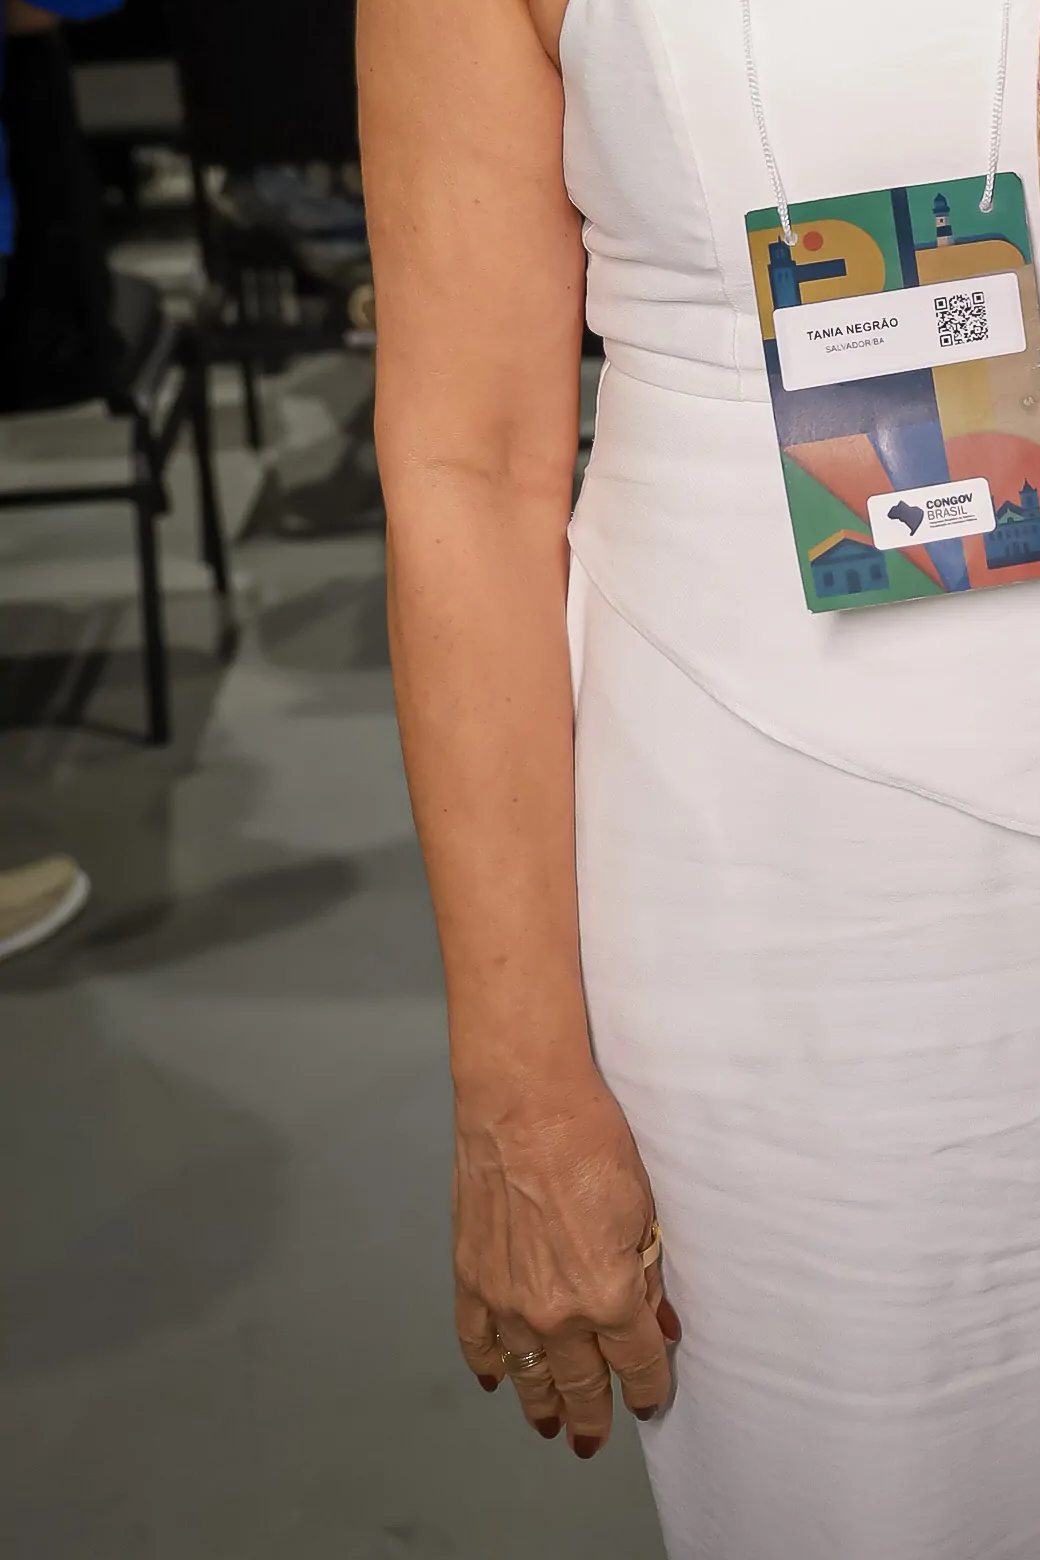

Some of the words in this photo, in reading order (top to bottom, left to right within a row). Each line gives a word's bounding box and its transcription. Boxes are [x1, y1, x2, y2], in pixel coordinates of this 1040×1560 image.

[806, 327, 843, 341] TANIA
[846, 317, 898, 335] NEGRÃO
[926, 493, 972, 509] CONGOV
[927, 505, 967, 520] BRASIL
